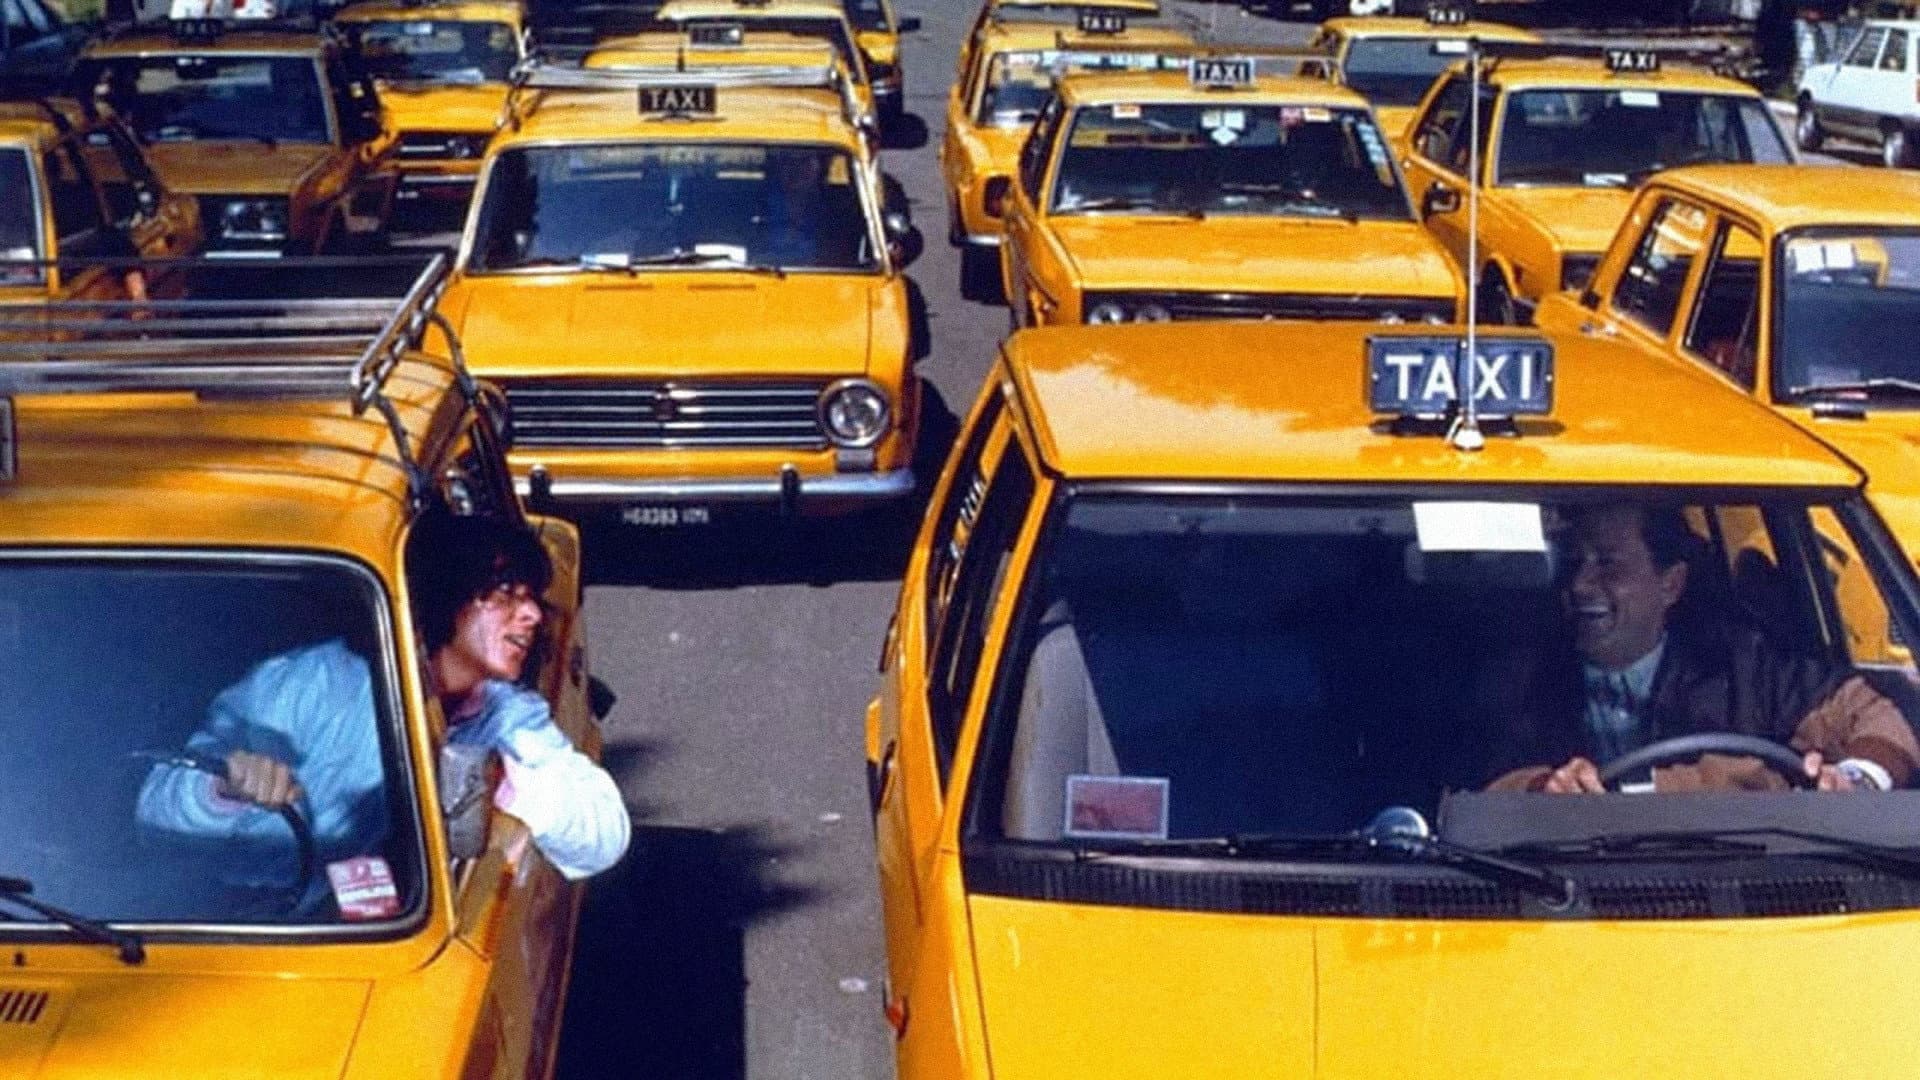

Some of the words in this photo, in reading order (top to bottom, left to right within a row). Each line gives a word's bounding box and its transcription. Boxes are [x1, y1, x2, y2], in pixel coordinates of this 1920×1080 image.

[1082, 15, 1121, 29] TAXI
[1428, 9, 1465, 22] TAXI
[1609, 52, 1656, 68] TAXI
[1199, 62, 1246, 81] TAXI
[650, 89, 707, 109] TAXI
[1385, 354, 1532, 400] TAXI
